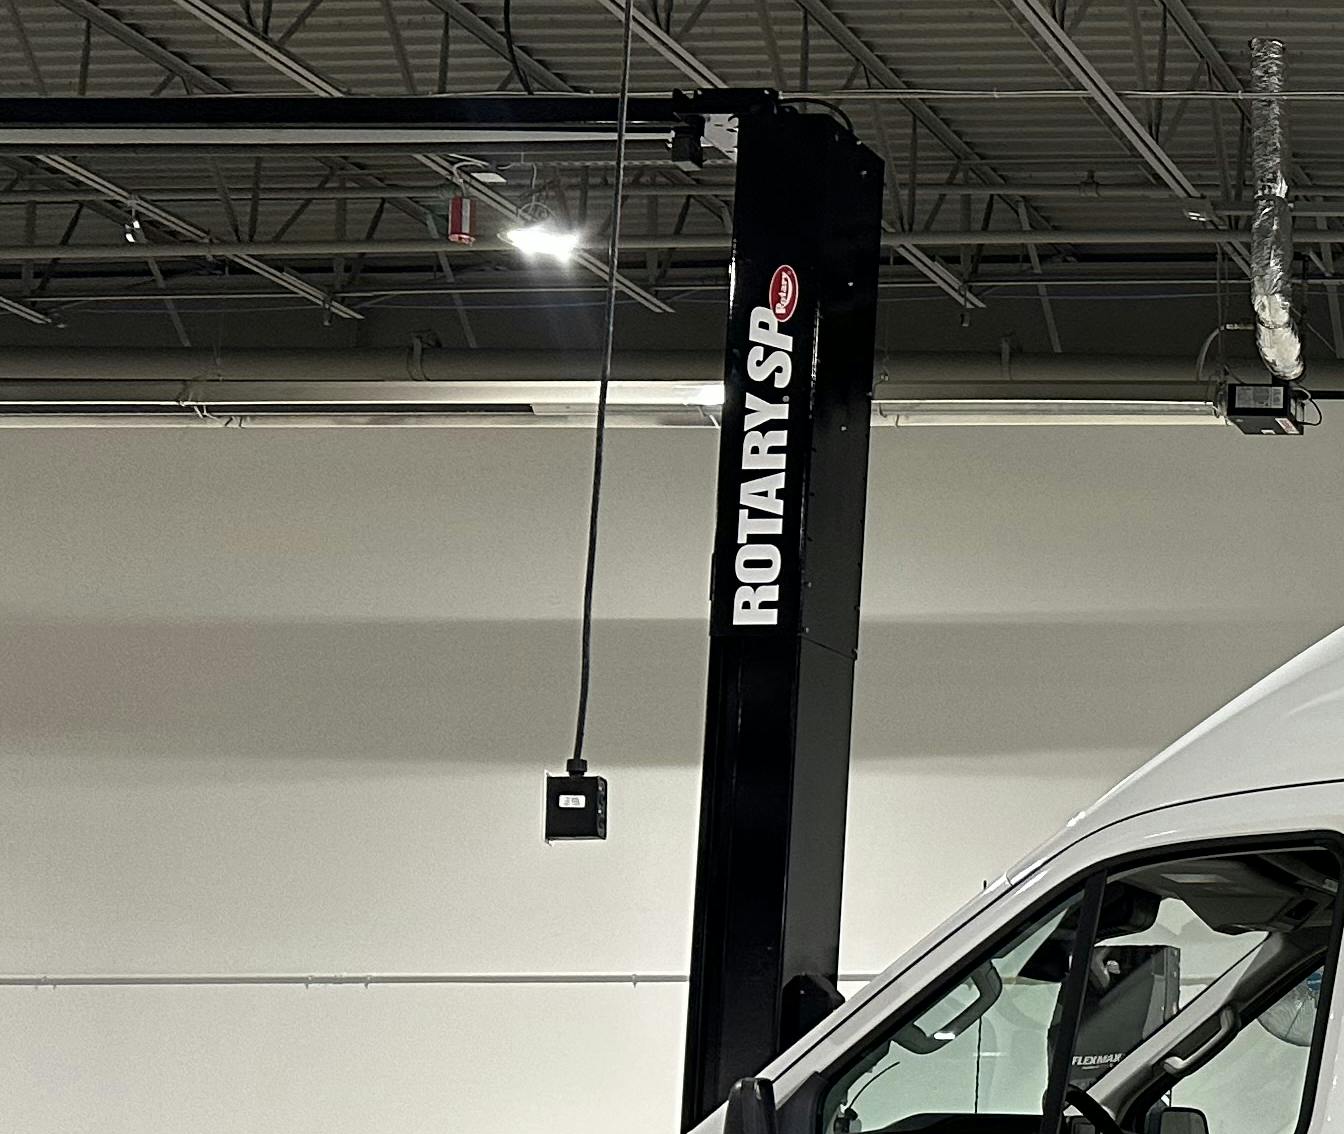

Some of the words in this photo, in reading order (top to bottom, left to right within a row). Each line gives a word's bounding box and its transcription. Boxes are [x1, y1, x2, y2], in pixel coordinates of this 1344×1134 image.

[775, 270, 793, 315] Rotary
[746, 306, 793, 389] SP
[733, 392, 789, 625] ROTARY
